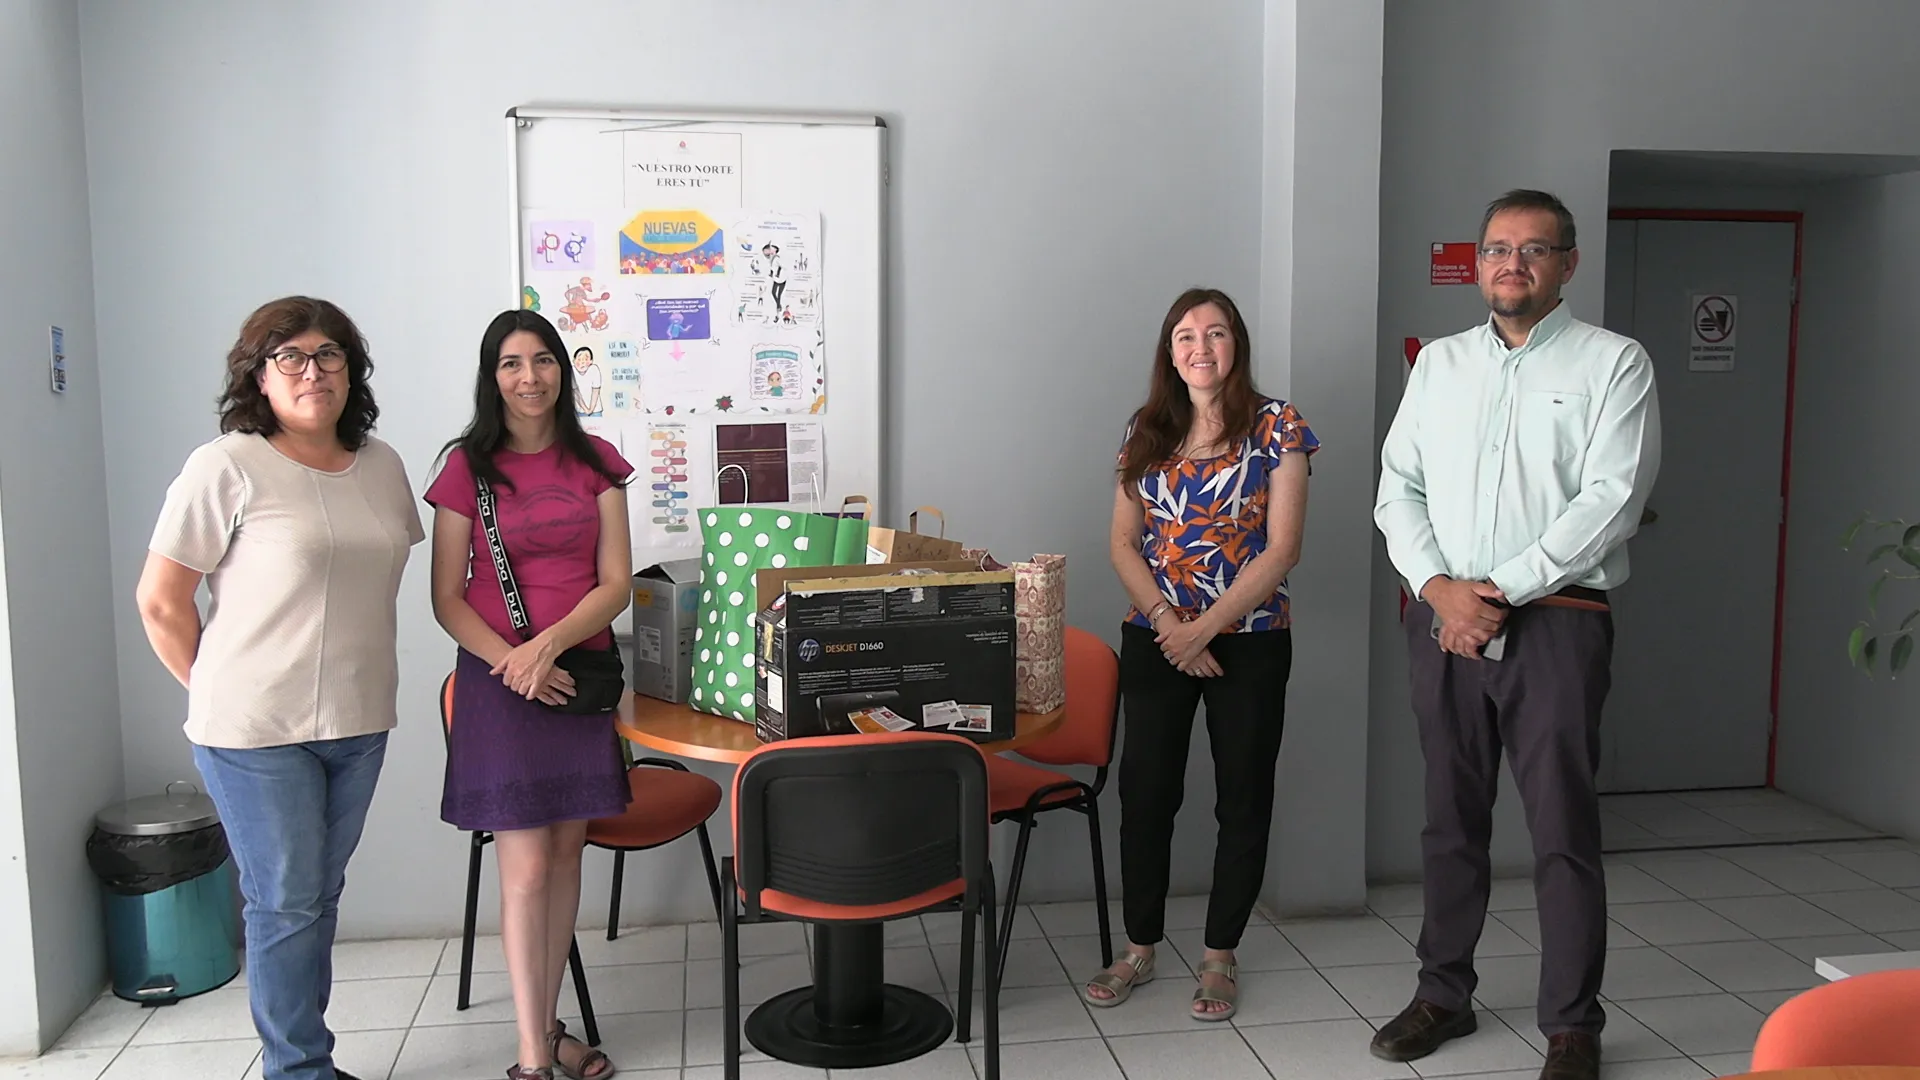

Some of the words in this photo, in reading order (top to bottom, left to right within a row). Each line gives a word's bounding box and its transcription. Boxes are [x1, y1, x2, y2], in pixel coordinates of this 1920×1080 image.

[695, 164, 734, 175] NORTE
[657, 178, 687, 187] ERES
[644, 222, 697, 235] NUEVAS
[487, 526, 509, 582] bubba
[799, 638, 820, 662] hp
[825, 643, 858, 653] DESKJET
[859, 641, 884, 652] D1660
